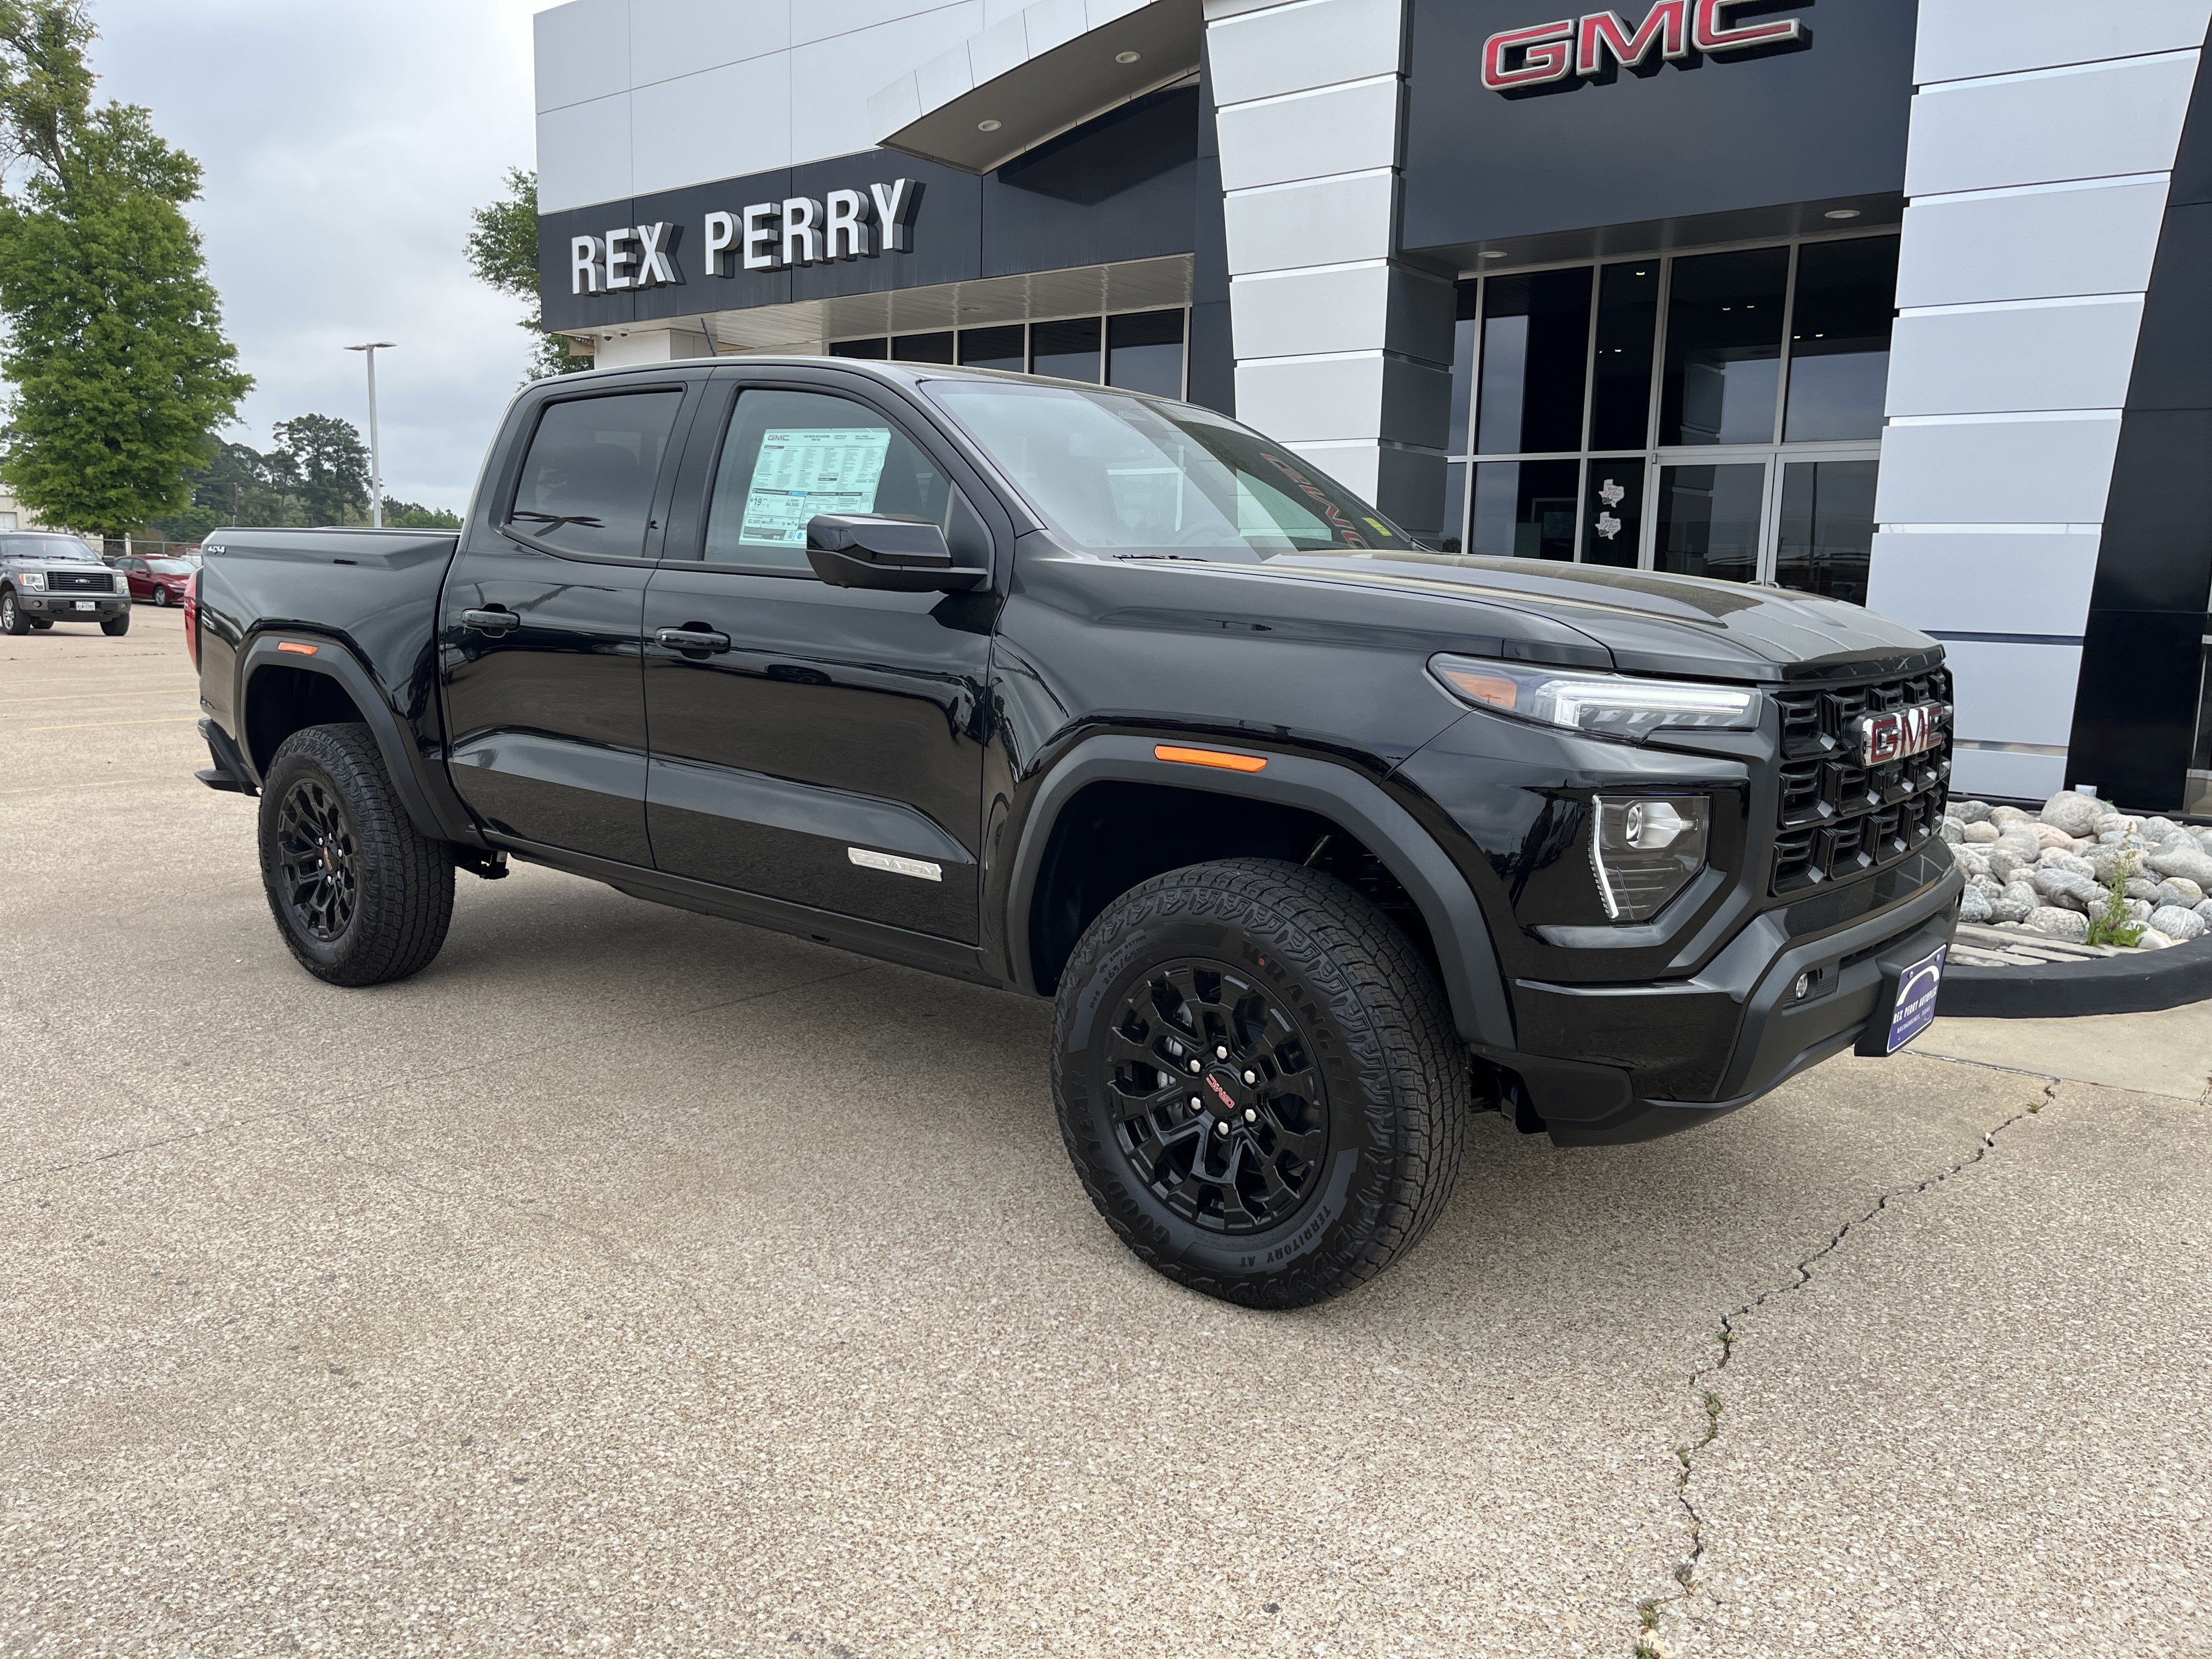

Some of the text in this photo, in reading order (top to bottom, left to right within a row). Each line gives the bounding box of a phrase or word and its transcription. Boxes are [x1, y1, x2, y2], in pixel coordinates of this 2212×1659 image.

[1481, 0, 1801, 91] GMC
[571, 178, 916, 295] REX PERRY
[1863, 702, 1944, 767] GMC
[854, 853, 934, 874] ELEVATION
[1893, 1009, 1903, 1024] REX
[1904, 1000, 1918, 1018] PERRY
[1206, 1073, 1235, 1108] GMC
[1071, 1070, 1171, 1245] GOODYEAR
[1239, 1205, 1331, 1268] TERRITORY AT
